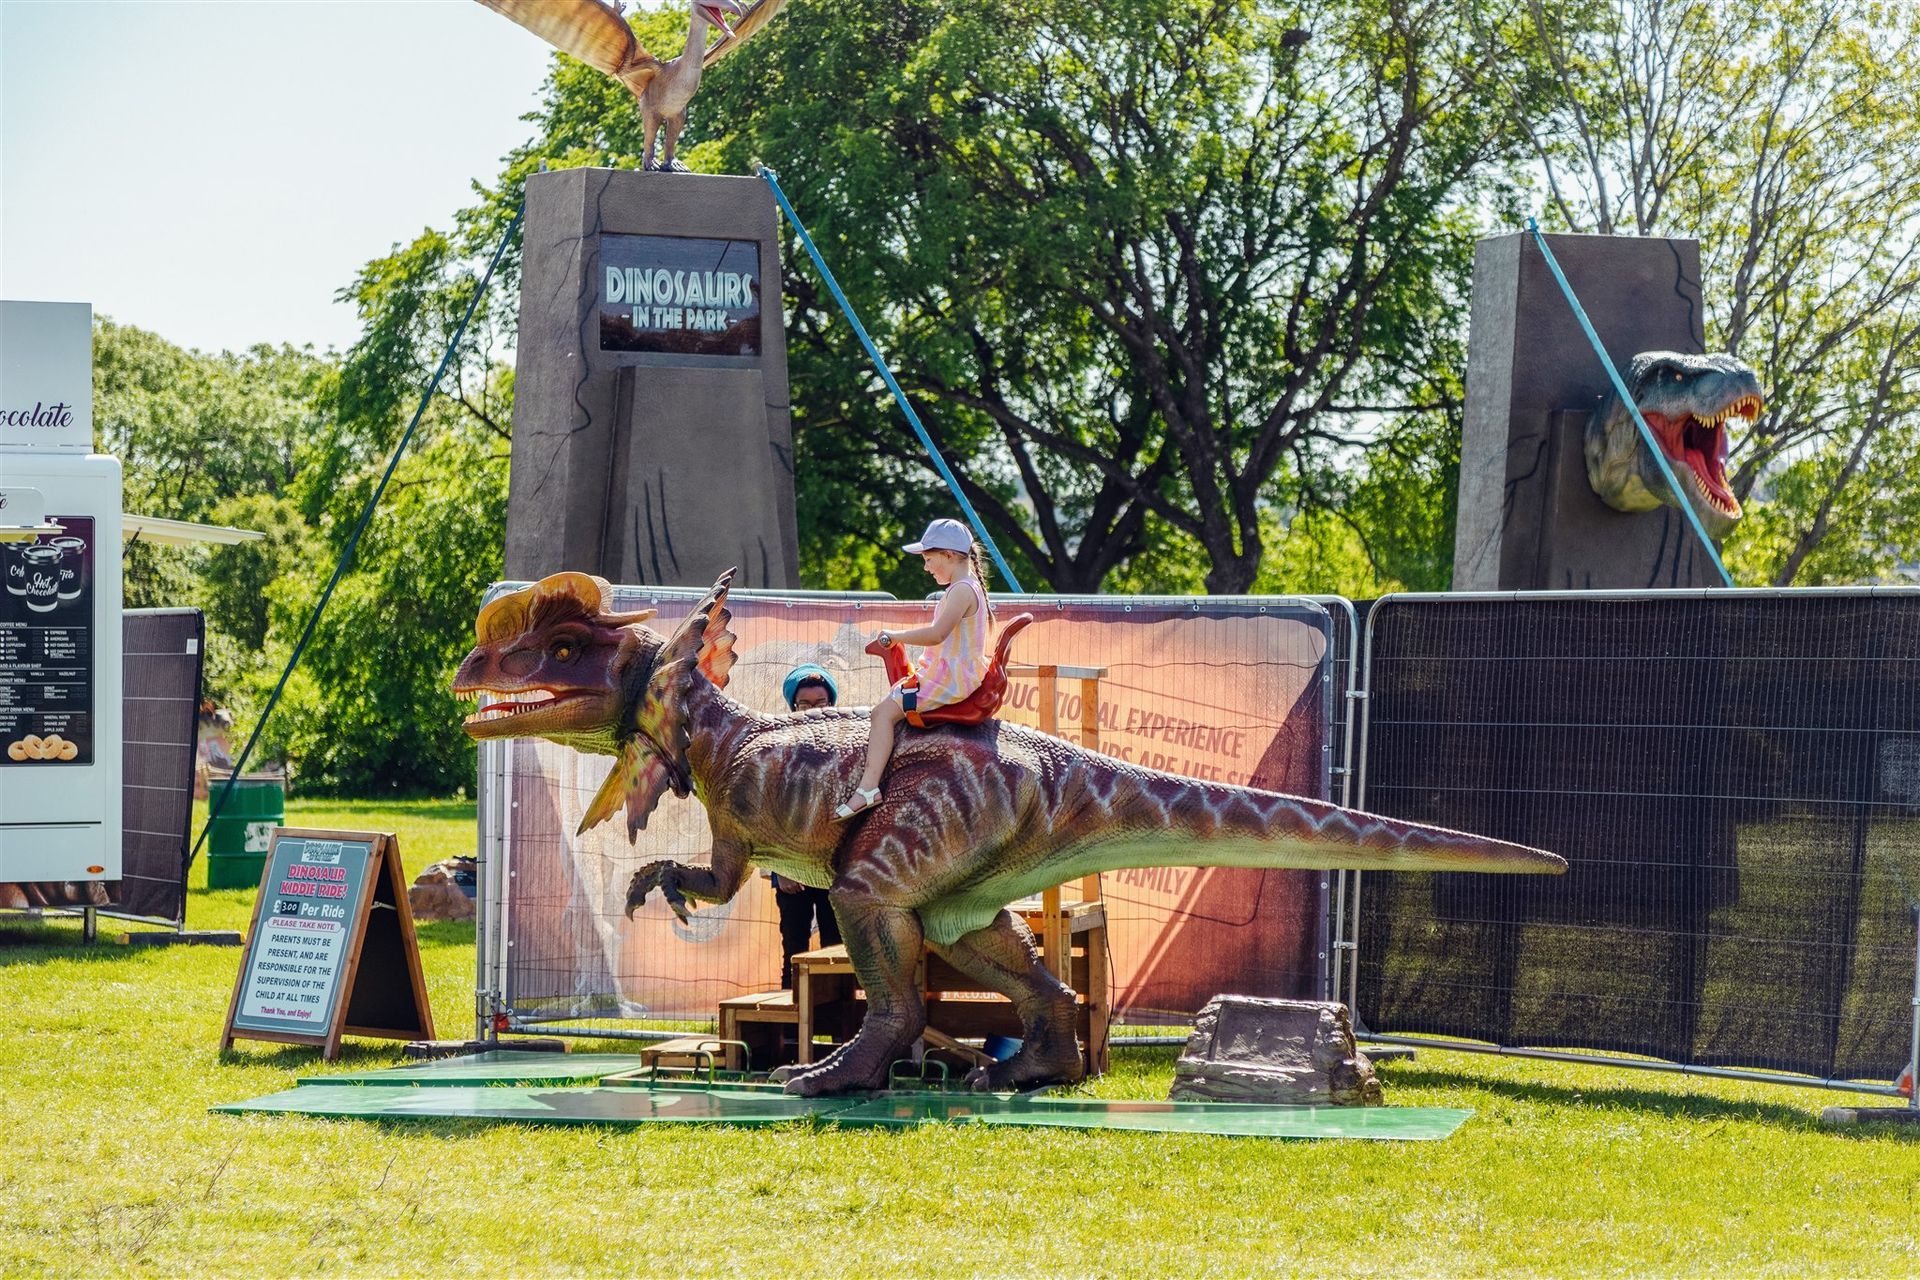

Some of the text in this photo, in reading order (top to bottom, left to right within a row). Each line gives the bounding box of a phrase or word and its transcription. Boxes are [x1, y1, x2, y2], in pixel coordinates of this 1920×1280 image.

[606, 266, 753, 308] DINOSAURS
[632, 306, 727, 331] IN THE PARK
[33, 572, 53, 589] Hot
[1126, 707, 1246, 759] EXPERIENCE
[287, 864, 346, 881] DINOSAUR
[279, 880, 348, 900] KIDDIE RIDE!
[300, 902, 320, 917] Per
[321, 904, 345, 919] Ride
[272, 919, 297, 928] PLEASE
[300, 921, 316, 929] TAKE
[271, 934, 332, 947] PARENTS MUST BE
[267, 948, 328, 961] PRESENT, AND ARE
[257, 962, 332, 976] RESPONSIBLE FOR THE
[256, 976, 326, 990] SUPERVISION OF THE
[255, 990, 320, 1004] CHILD AT ALL TIMES
[260, 1006, 276, 1015] Thank
[287, 1009, 297, 1017] and
[297, 1010, 312, 1019] Enjoy!
